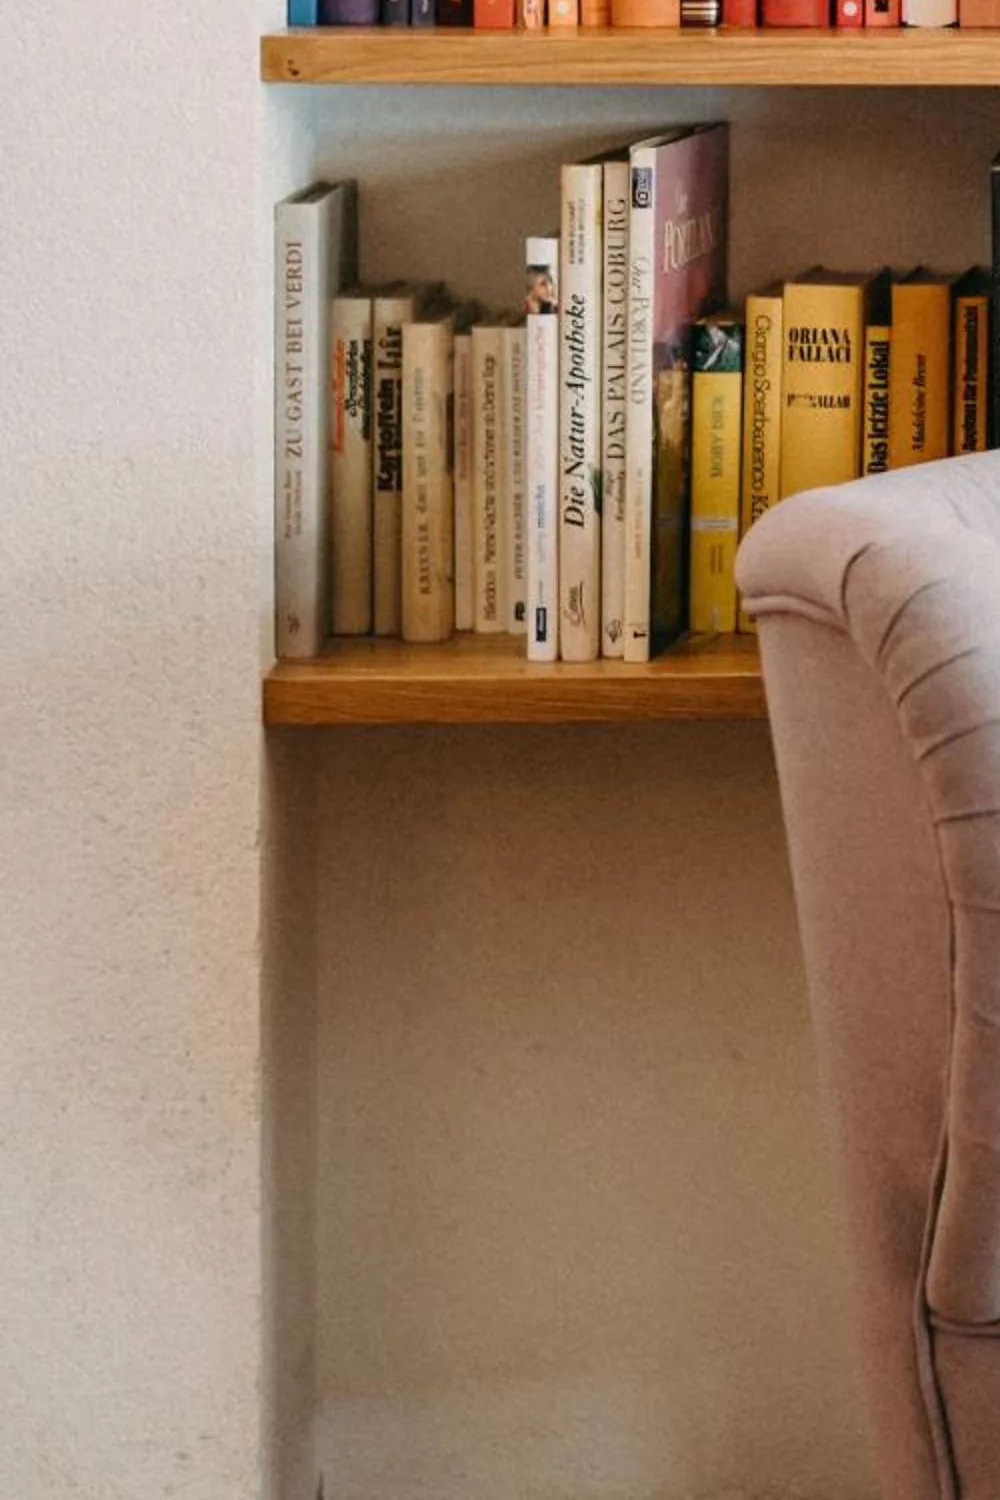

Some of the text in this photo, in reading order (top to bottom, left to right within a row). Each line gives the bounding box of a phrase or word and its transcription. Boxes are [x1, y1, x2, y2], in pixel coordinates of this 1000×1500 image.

[285, 241, 303, 312] VERDI
[285, 319, 303, 355] BEI
[606, 198, 627, 460] DAS PALAIS COBURG
[788, 326, 851, 345] ORIANA
[788, 345, 851, 363] FALLACI
[285, 361, 303, 422] GAST
[563, 292, 588, 528] Die Natur-Apotheke
[867, 340, 889, 473] Das letzte Lokal
[285, 428, 303, 459] ZU
[708, 394, 724, 478] MOBY DICK
